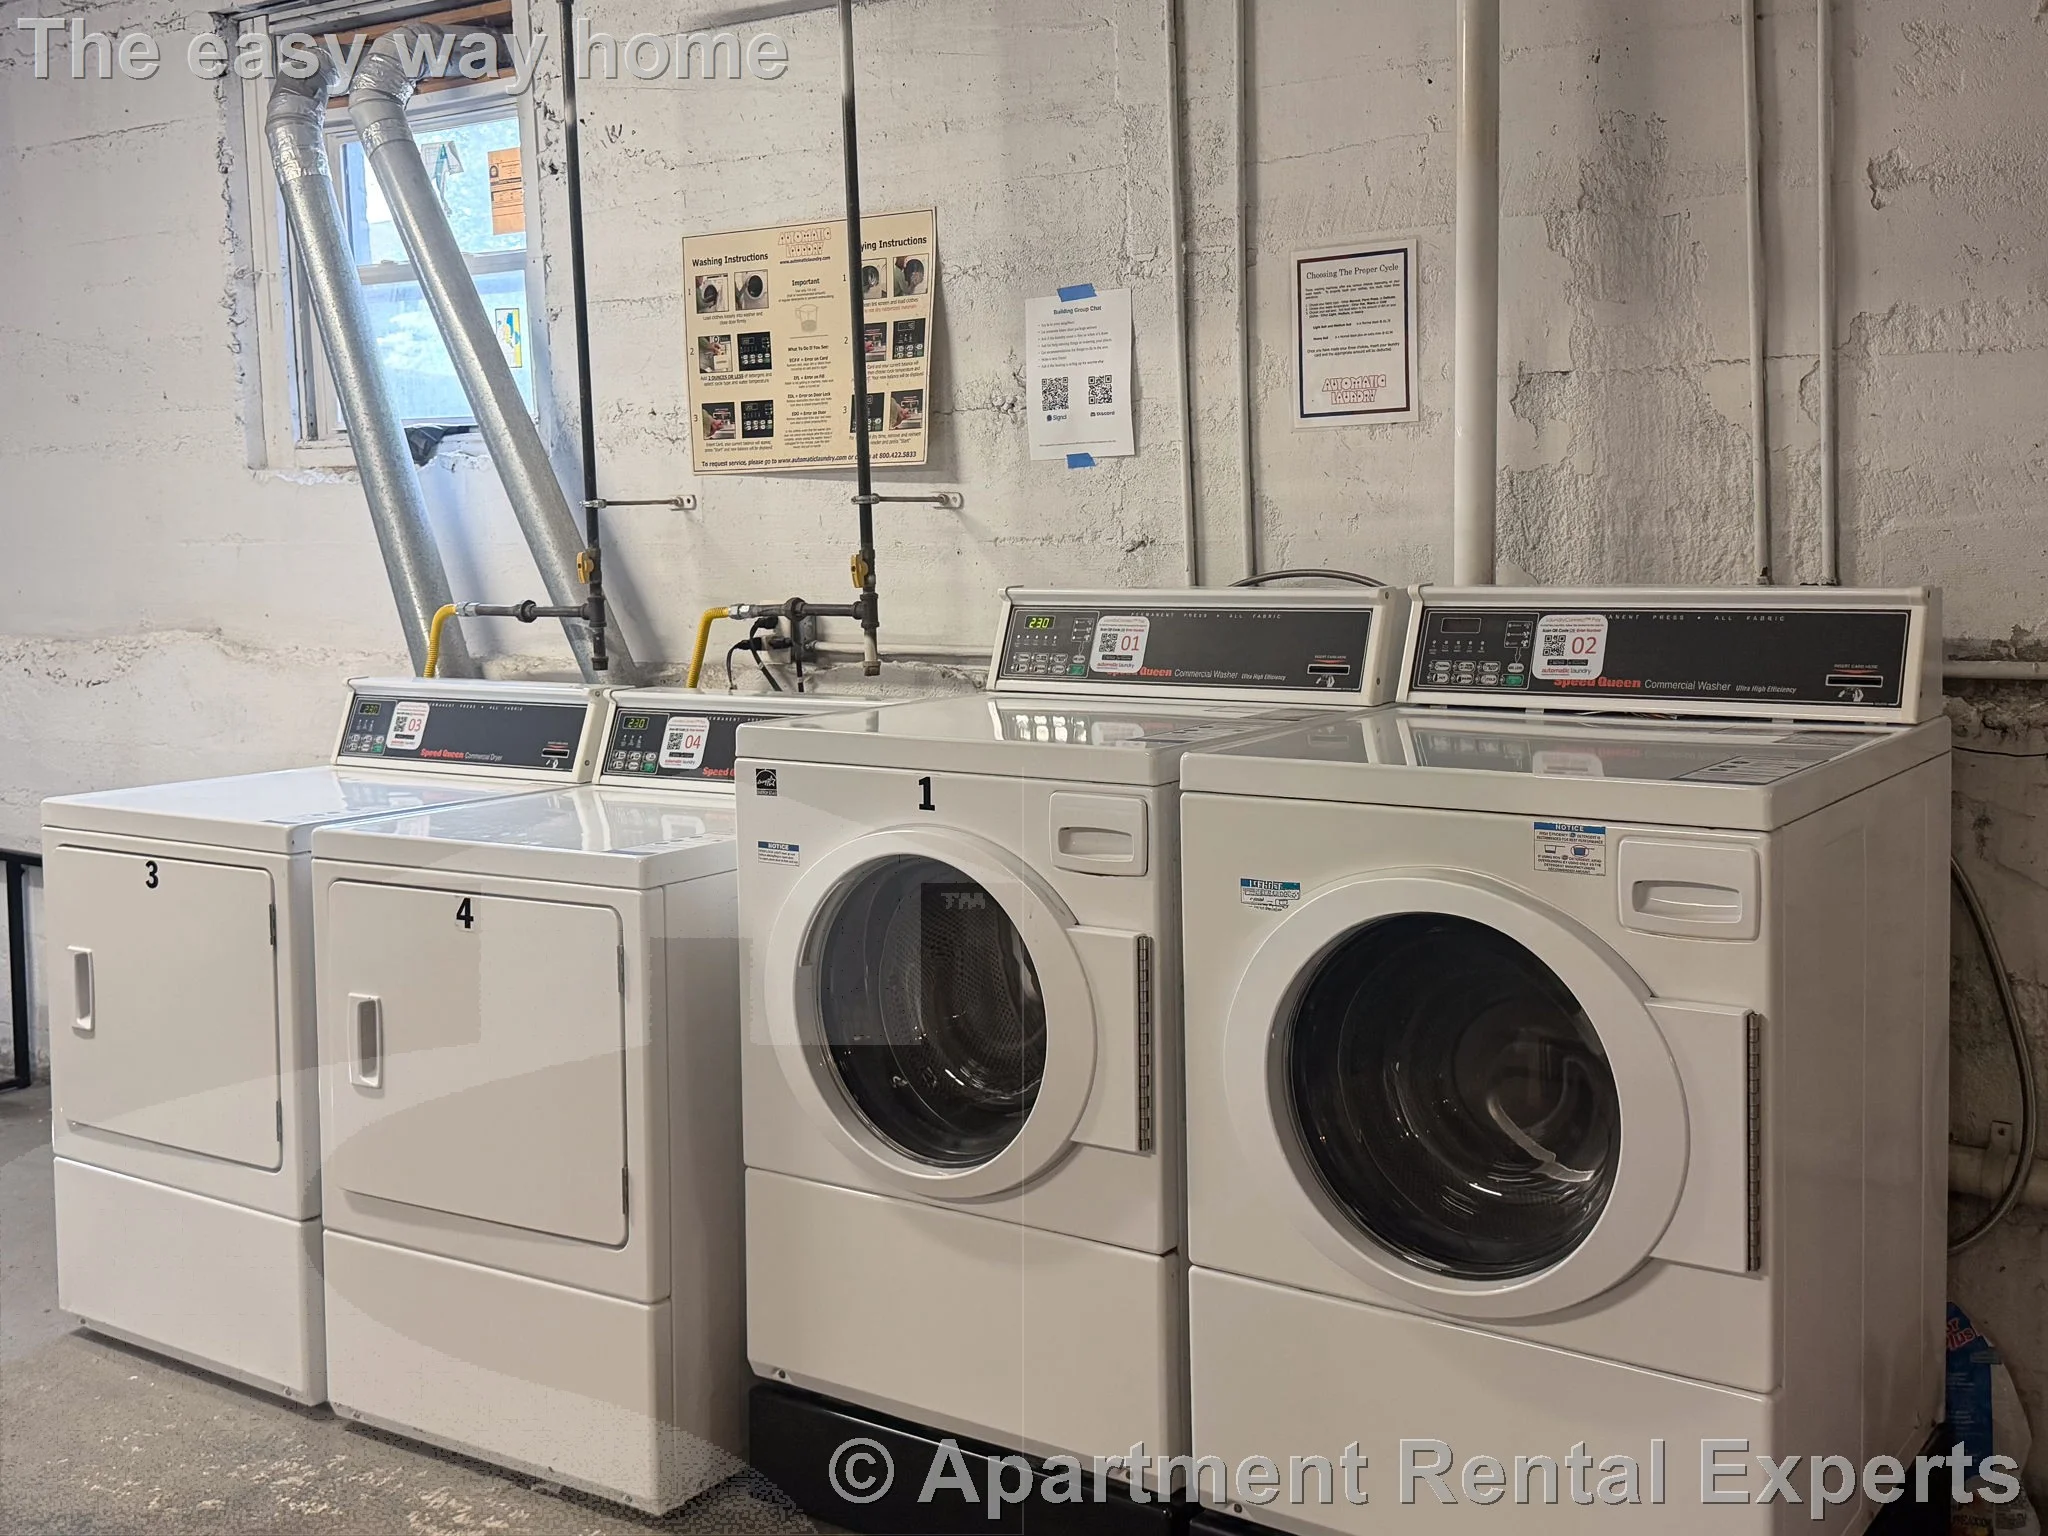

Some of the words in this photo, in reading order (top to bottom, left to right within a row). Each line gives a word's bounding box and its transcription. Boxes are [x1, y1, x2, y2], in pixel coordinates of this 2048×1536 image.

[778, 227, 831, 245] AUTOMATIC
[879, 237, 927, 249] Instructions
[786, 242, 824, 258] LAUNDRY
[692, 257, 722, 267] Washing
[724, 253, 768, 264] Instructions
[1306, 270, 1338, 280] Choosing
[1339, 267, 1353, 276] The
[1354, 266, 1378, 276] Proper
[1379, 263, 1399, 272] Cycle
[792, 278, 820, 287] Important
[1322, 374, 1386, 392] AUTOMATIC
[1331, 388, 1377, 405] LAUNDRY
[694, 414, 698, 422] 3
[842, 406, 847, 414] 3
[1120, 635, 1140, 651] 01
[1572, 636, 1597, 654] 02
[1140, 666, 1172, 677] Queen
[1174, 669, 1212, 678] Commercial
[1214, 670, 1238, 679] Washer
[1598, 676, 1641, 688] Queen
[1644, 679, 1696, 690] Commercial
[1698, 680, 1731, 691] Washer
[1751, 685, 1766, 693] High
[1766, 686, 1797, 694] Efficiency
[408, 718, 422, 732] 03
[684, 734, 701, 750] 04
[420, 748, 442, 758] Speed
[442, 749, 464, 759] Queen
[464, 752, 490, 760] Commercial
[490, 753, 503, 762] Dryer
[703, 766, 730, 777] Speed
[918, 776, 936, 811] 1
[1555, 824, 1584, 832] NOTICE
[768, 842, 790, 850] NOTICE
[146, 861, 159, 889] 3
[456, 898, 474, 930] 4
